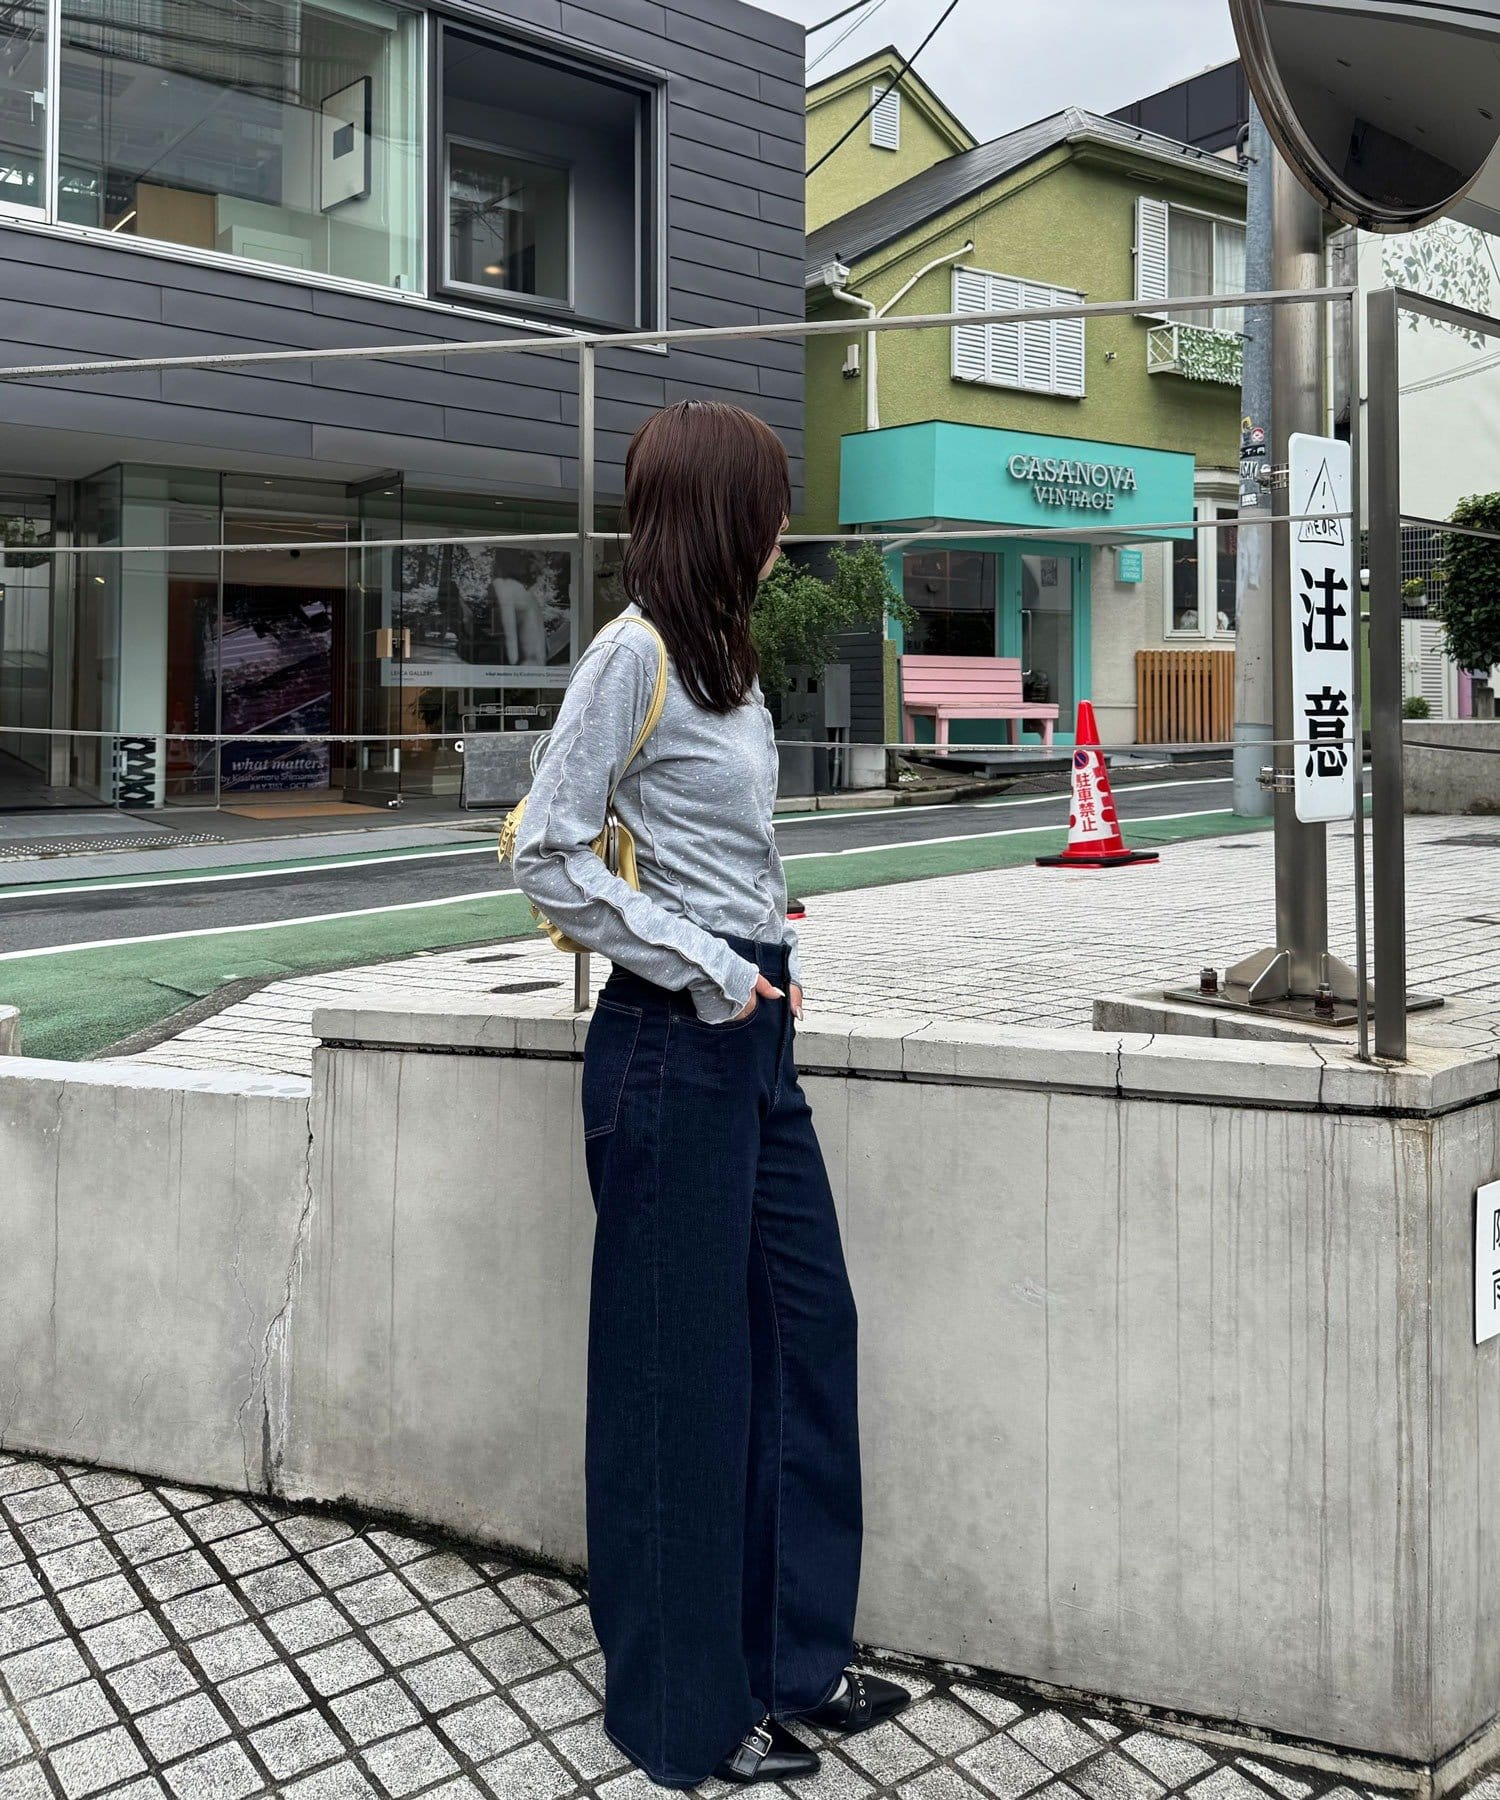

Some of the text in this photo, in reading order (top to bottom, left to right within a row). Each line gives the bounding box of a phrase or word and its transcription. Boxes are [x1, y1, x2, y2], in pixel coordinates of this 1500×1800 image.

[1008, 453, 1138, 490] CASANOVA
[1034, 484, 1115, 510] VINTAGE
[1299, 567, 1349, 778] 注意
[231, 758, 325, 771] what matters
[1075, 772, 1099, 832] 駐車禁止
